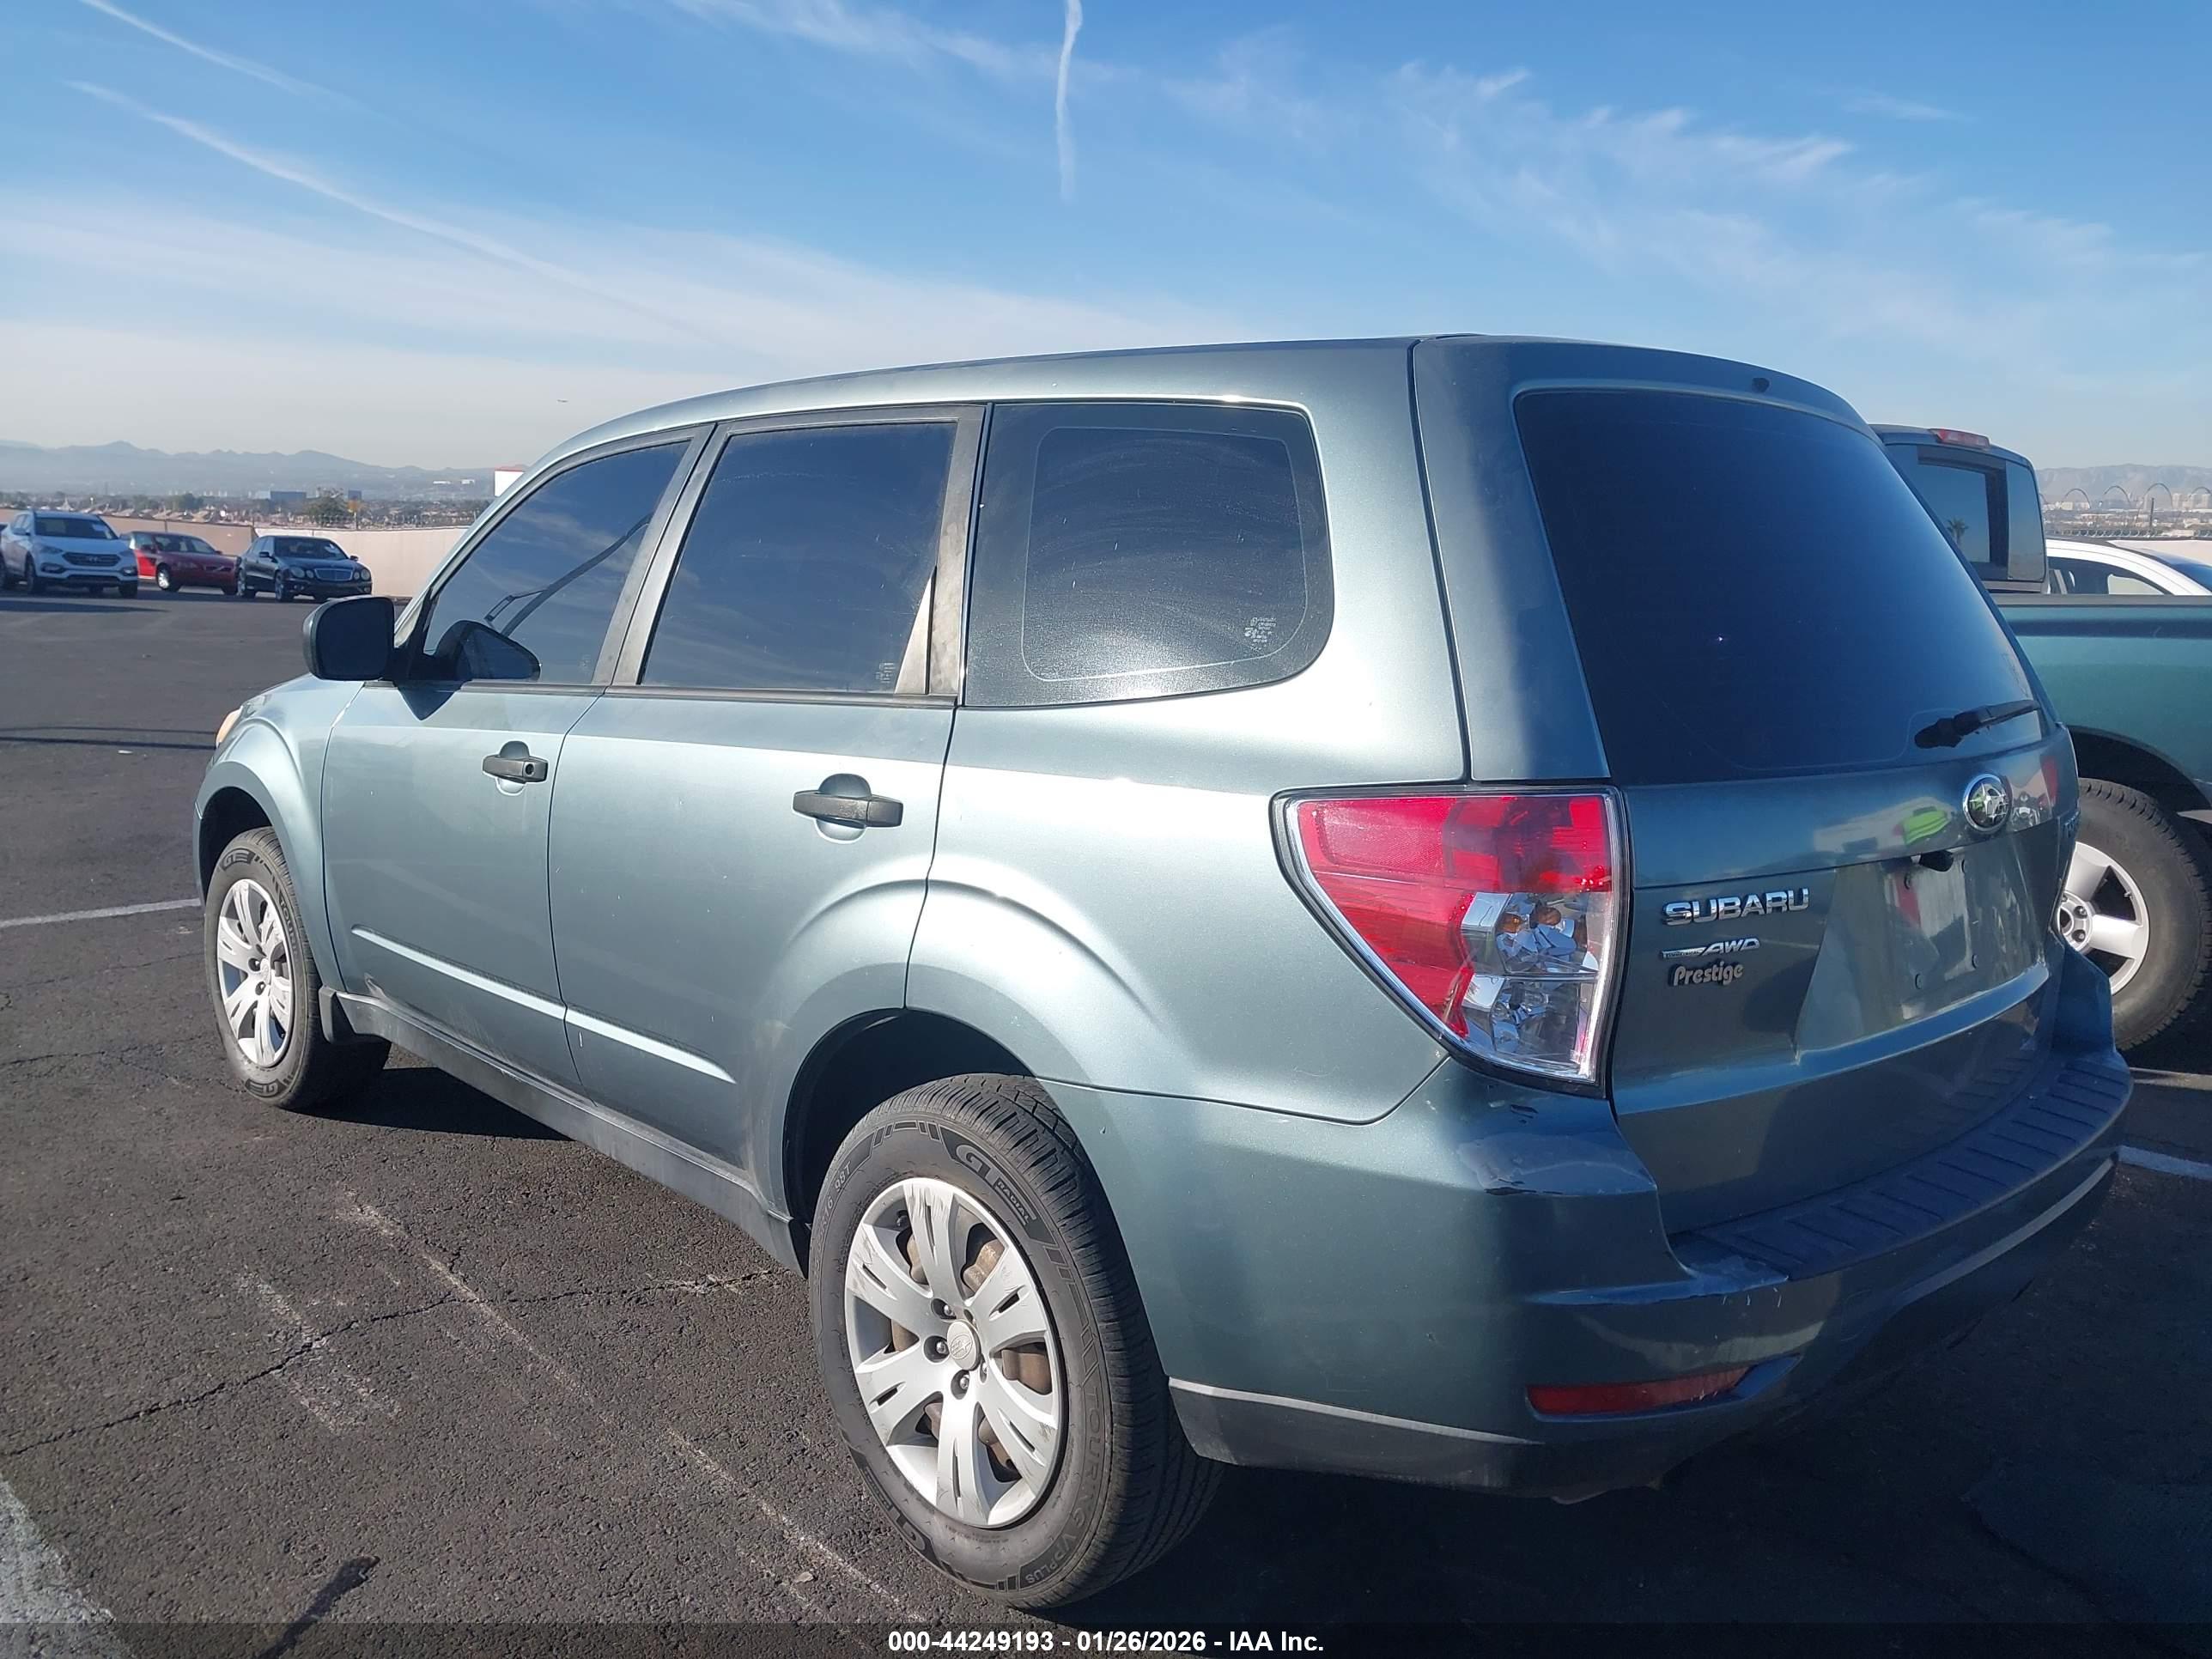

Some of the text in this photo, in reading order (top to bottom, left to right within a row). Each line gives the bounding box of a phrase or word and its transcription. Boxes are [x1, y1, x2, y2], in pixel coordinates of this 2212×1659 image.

[1664, 888, 1809, 926] SUBARU
[1703, 938, 1760, 956] AWD
[1674, 961, 1744, 986] Prestige
[833, 1160, 852, 1193] 98T
[956, 1144, 1032, 1221] GT RADIAL
